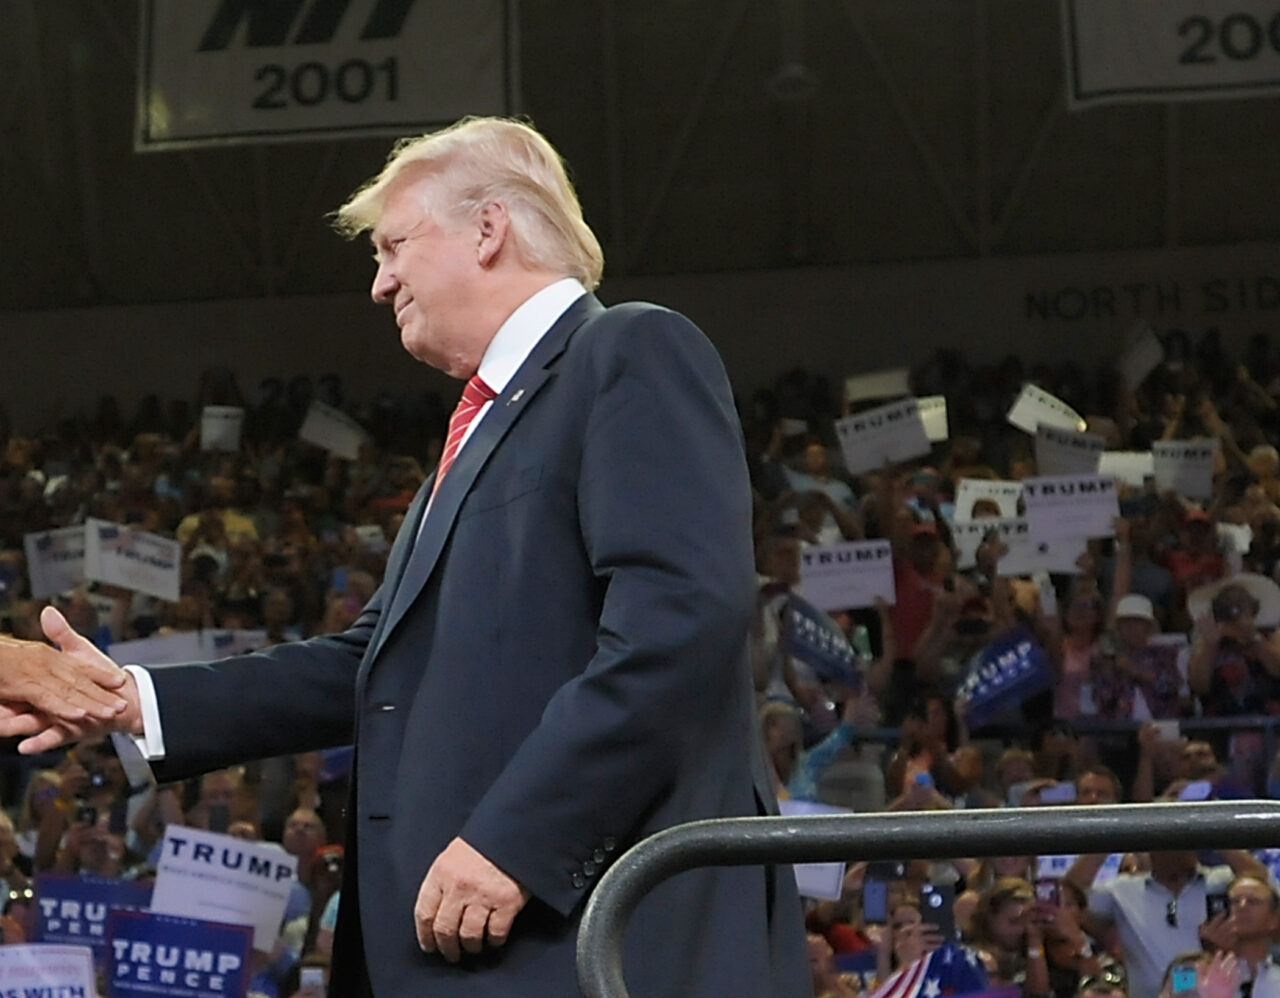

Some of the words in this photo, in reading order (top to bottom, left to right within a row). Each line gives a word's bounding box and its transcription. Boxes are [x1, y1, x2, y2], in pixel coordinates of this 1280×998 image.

[252, 56, 399, 109] 2001
[1024, 281, 1181, 321] NORTH
[168, 836, 295, 883] TRUMP
[47, 920, 105, 937] PEN
[112, 939, 241, 975] TRUMP
[117, 964, 225, 991] PENCE
